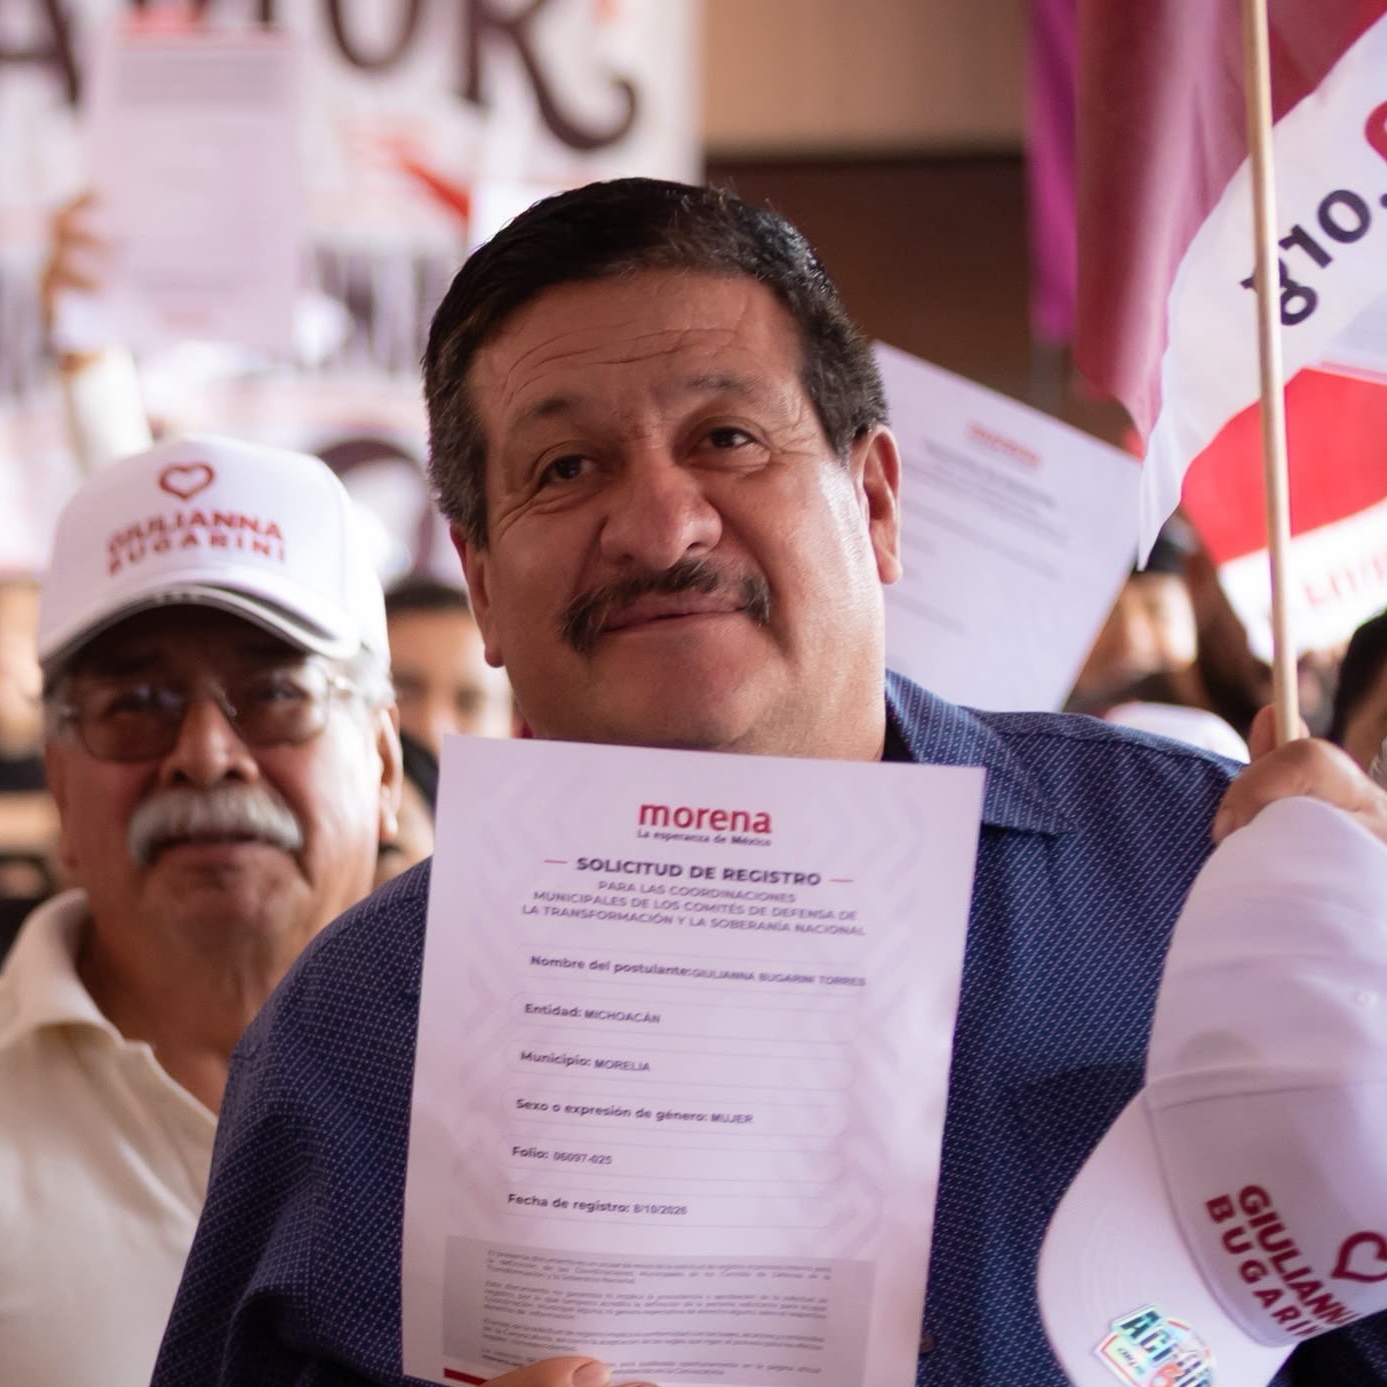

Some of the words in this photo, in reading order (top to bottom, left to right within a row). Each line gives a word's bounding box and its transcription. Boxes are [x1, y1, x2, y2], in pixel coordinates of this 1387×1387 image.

[106, 509, 285, 552] GIULIANNA
[638, 803, 772, 834] morena
[576, 856, 683, 877] SOLICITUD
[688, 864, 716, 880] DE
[721, 867, 821, 886] REGISTRO
[532, 890, 628, 907] MUNICIPALES
[629, 896, 650, 909] DE
[652, 898, 681, 911] LOS
[682, 900, 746, 915] COMITÉS
[747, 905, 767, 916] DE
[770, 906, 835, 920] DEFENSA
[837, 910, 857, 921] DE
[597, 879, 637, 892] PARA
[638, 883, 666, 895] LAS
[668, 884, 796, 904] COORDINACIONES
[521, 903, 540, 915] LA
[542, 905, 674, 925] TRANSFORMACIÓN
[676, 915, 686, 925] Y
[688, 916, 707, 927] LA
[709, 917, 791, 932] SOBERANÍA
[793, 922, 865, 936] NACIONAL
[529, 954, 586, 969] Nombre
[587, 959, 611, 971] del
[757, 971, 815, 983] BUGARINI
[818, 974, 866, 987] TORRES
[523, 1002, 582, 1017] Entidad:
[583, 1008, 661, 1023] MICHOACÁN
[519, 1050, 592, 1067] Municipio:
[593, 1058, 650, 1071] MORELIA
[515, 1097, 549, 1111] Sexo
[551, 1103, 561, 1112] o
[563, 1104, 632, 1117] expresión
[634, 1107, 652, 1119] de
[654, 1109, 708, 1122] género:
[709, 1112, 753, 1124] MUJER
[511, 1145, 549, 1159] Folio:
[552, 1150, 612, 1165] 06097-025
[507, 1192, 548, 1207] Fecha
[551, 1196, 569, 1209] de
[572, 1199, 630, 1213] registro:
[632, 1203, 687, 1215] 8/10/2026
